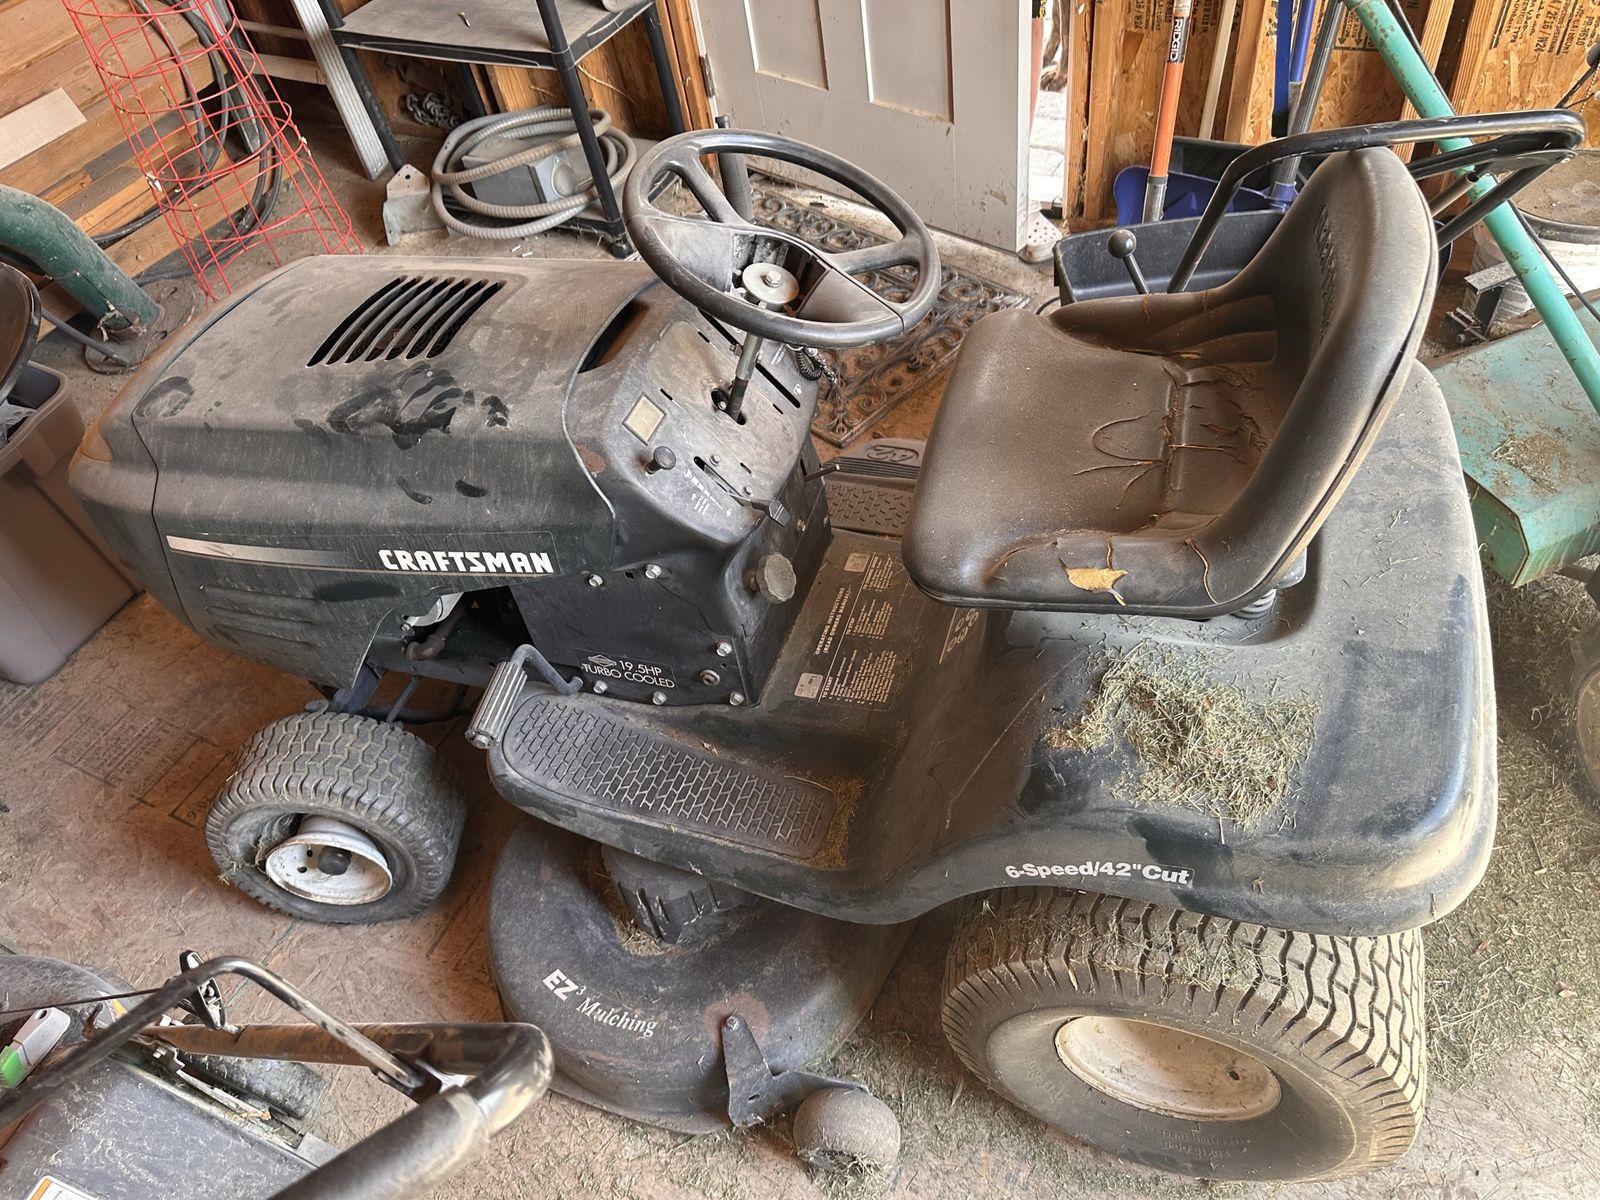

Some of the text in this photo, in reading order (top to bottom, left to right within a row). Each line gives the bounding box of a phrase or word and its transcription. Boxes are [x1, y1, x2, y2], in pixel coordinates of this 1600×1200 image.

[1170, 18, 1184, 61] RIDGID
[378, 549, 554, 573] CRAFTSMAN
[815, 587, 846, 655] OPERATING INSTRUCTIONS
[581, 663, 675, 689] TURBO COOLED
[619, 660, 662, 677] 19.5HP
[576, 996, 658, 1038] Mulching
